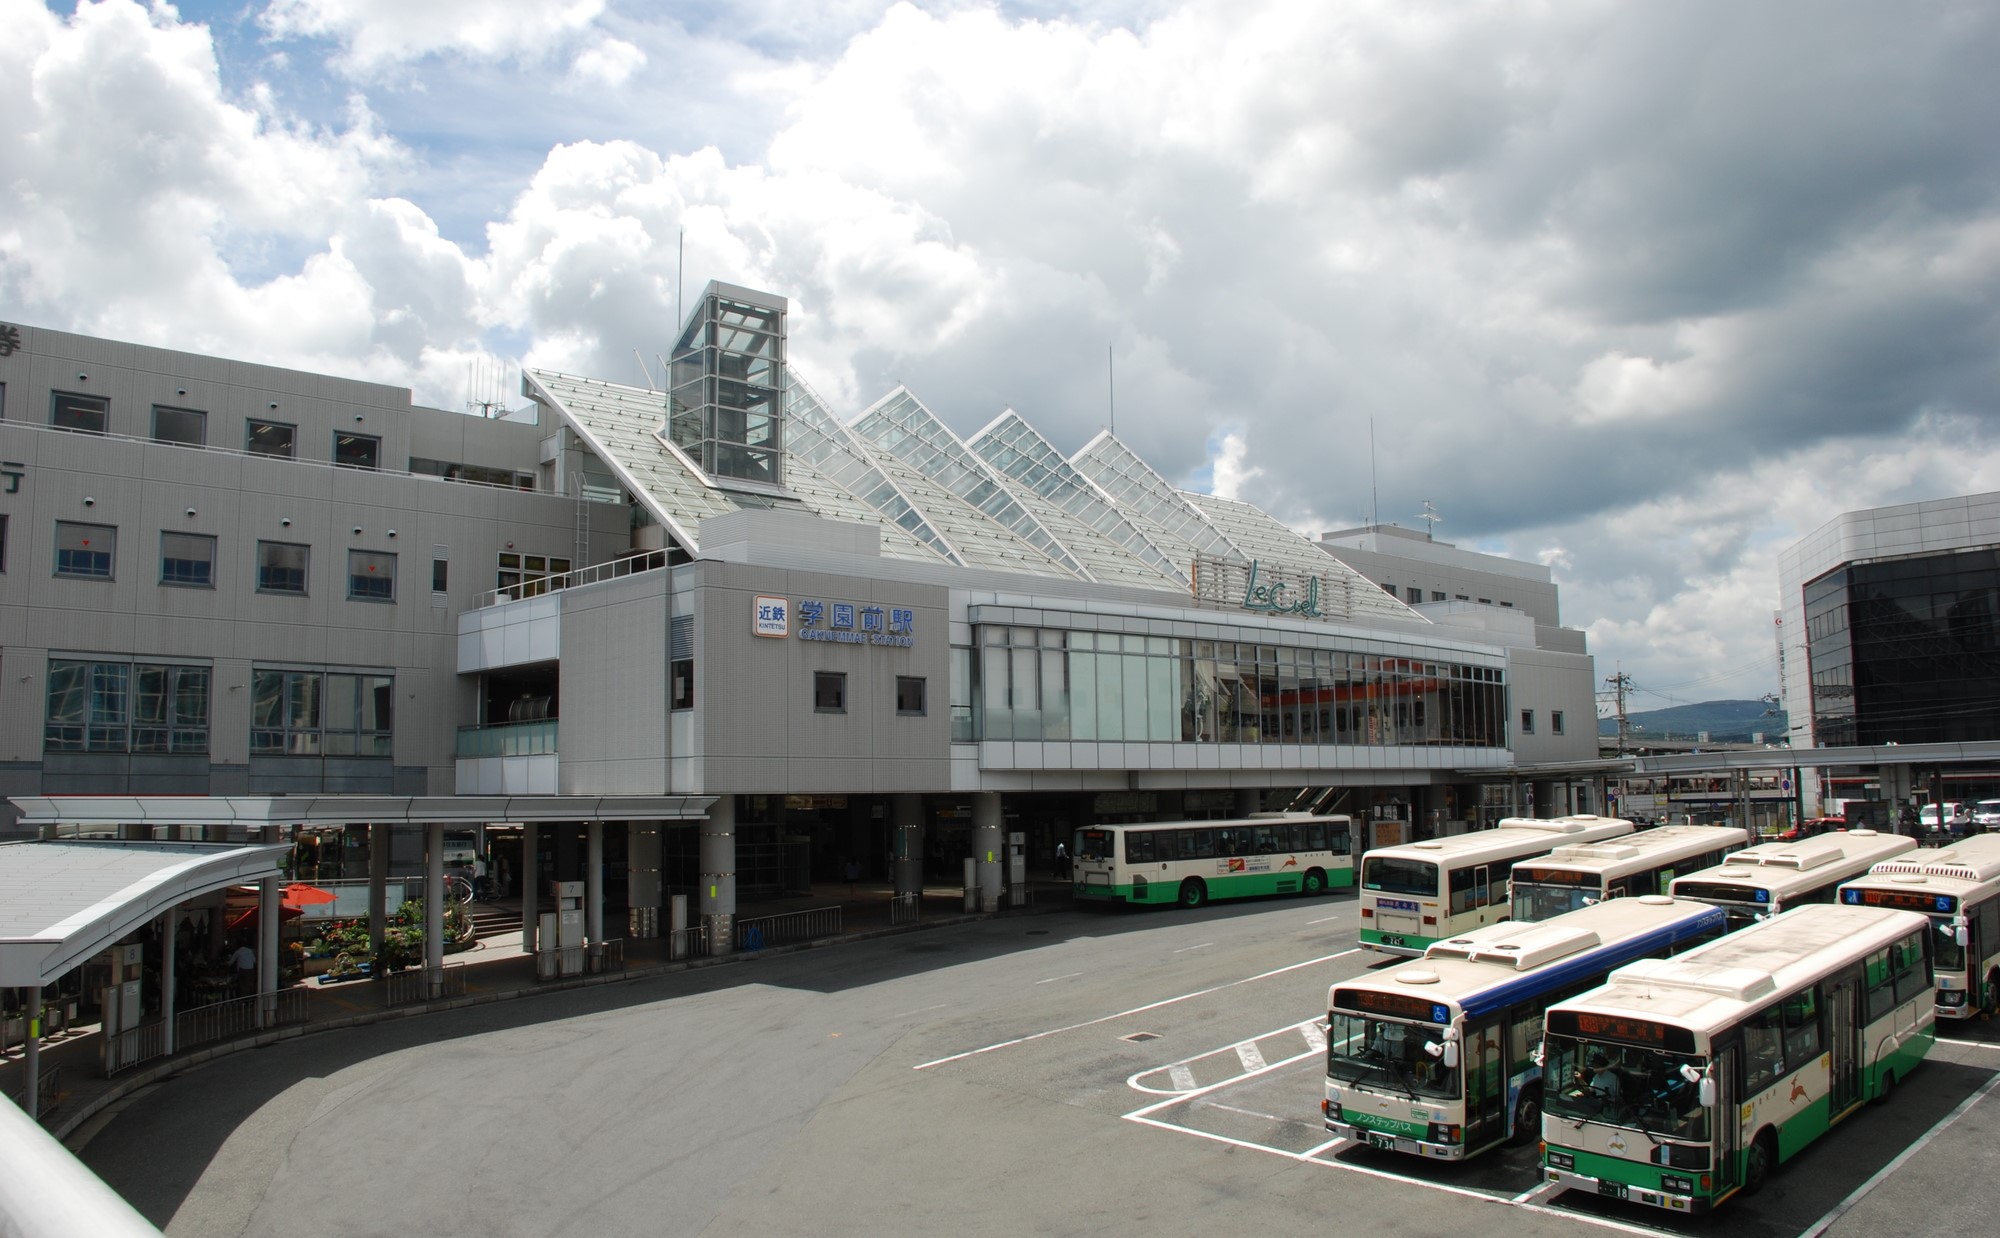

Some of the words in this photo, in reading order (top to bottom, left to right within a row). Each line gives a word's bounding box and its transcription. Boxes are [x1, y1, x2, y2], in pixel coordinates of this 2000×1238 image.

[1243, 558, 1271, 611] Le
[759, 606, 785, 622] 近鉄
[799, 601, 914, 634] 学園前駅
[759, 622, 786, 631] KINTETSU
[872, 634, 914, 648] STATION
[569, 885, 575, 894] 7
[1358, 1113, 1411, 1132] ノンステップバス
[1378, 1138, 1394, 1151] 734
[1617, 1187, 1627, 1198] 18
